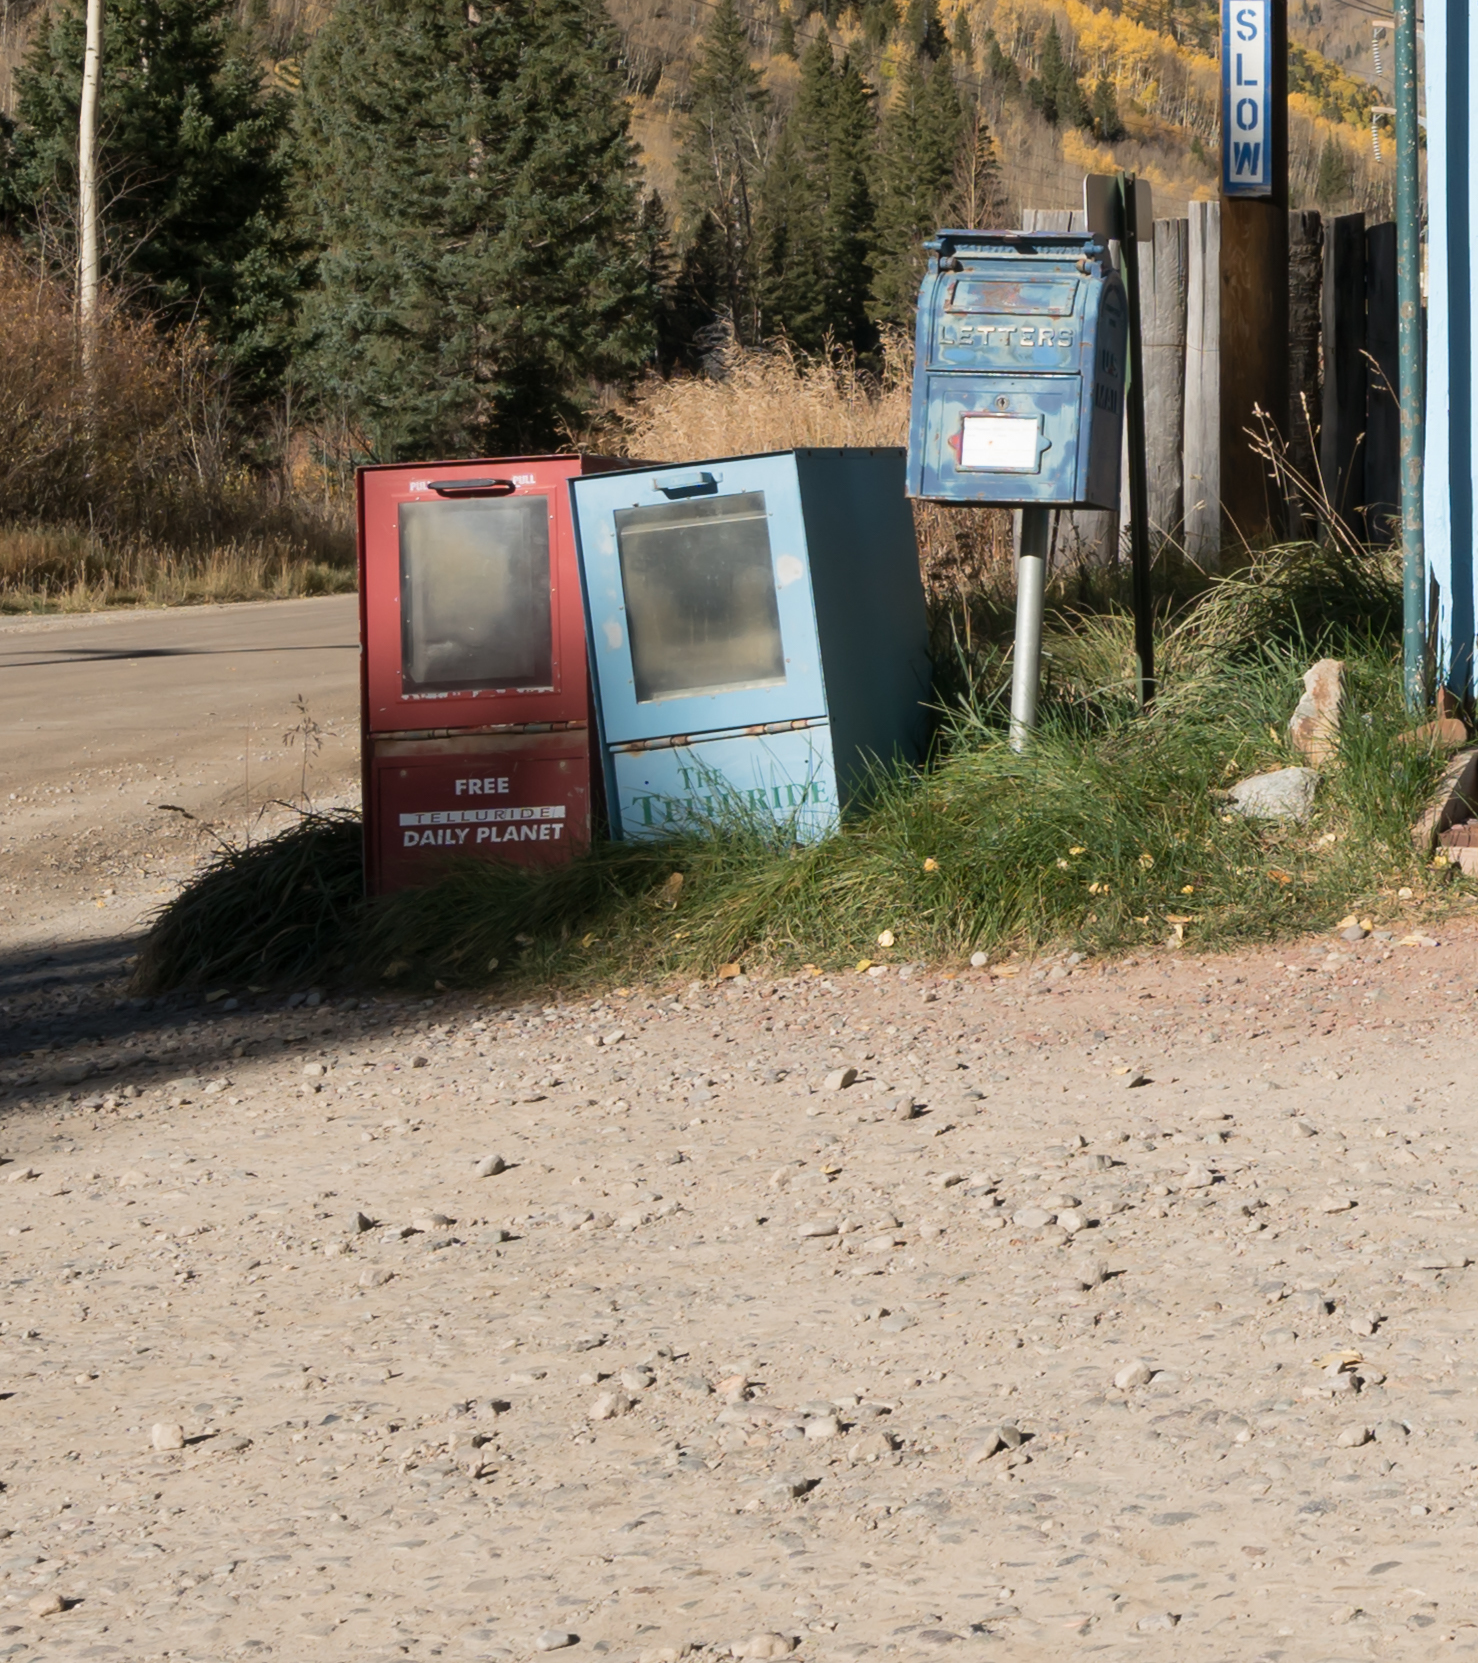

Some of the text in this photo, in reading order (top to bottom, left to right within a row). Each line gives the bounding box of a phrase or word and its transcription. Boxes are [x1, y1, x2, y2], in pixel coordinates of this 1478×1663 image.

[1233, 8, 1261, 176] SLOW
[939, 324, 1074, 348] LETTERS
[409, 474, 536, 492] PUL PULL
[455, 777, 510, 796] FREE
[415, 807, 552, 825] TELLURIDE
[403, 823, 564, 848] DAILY PLANET
